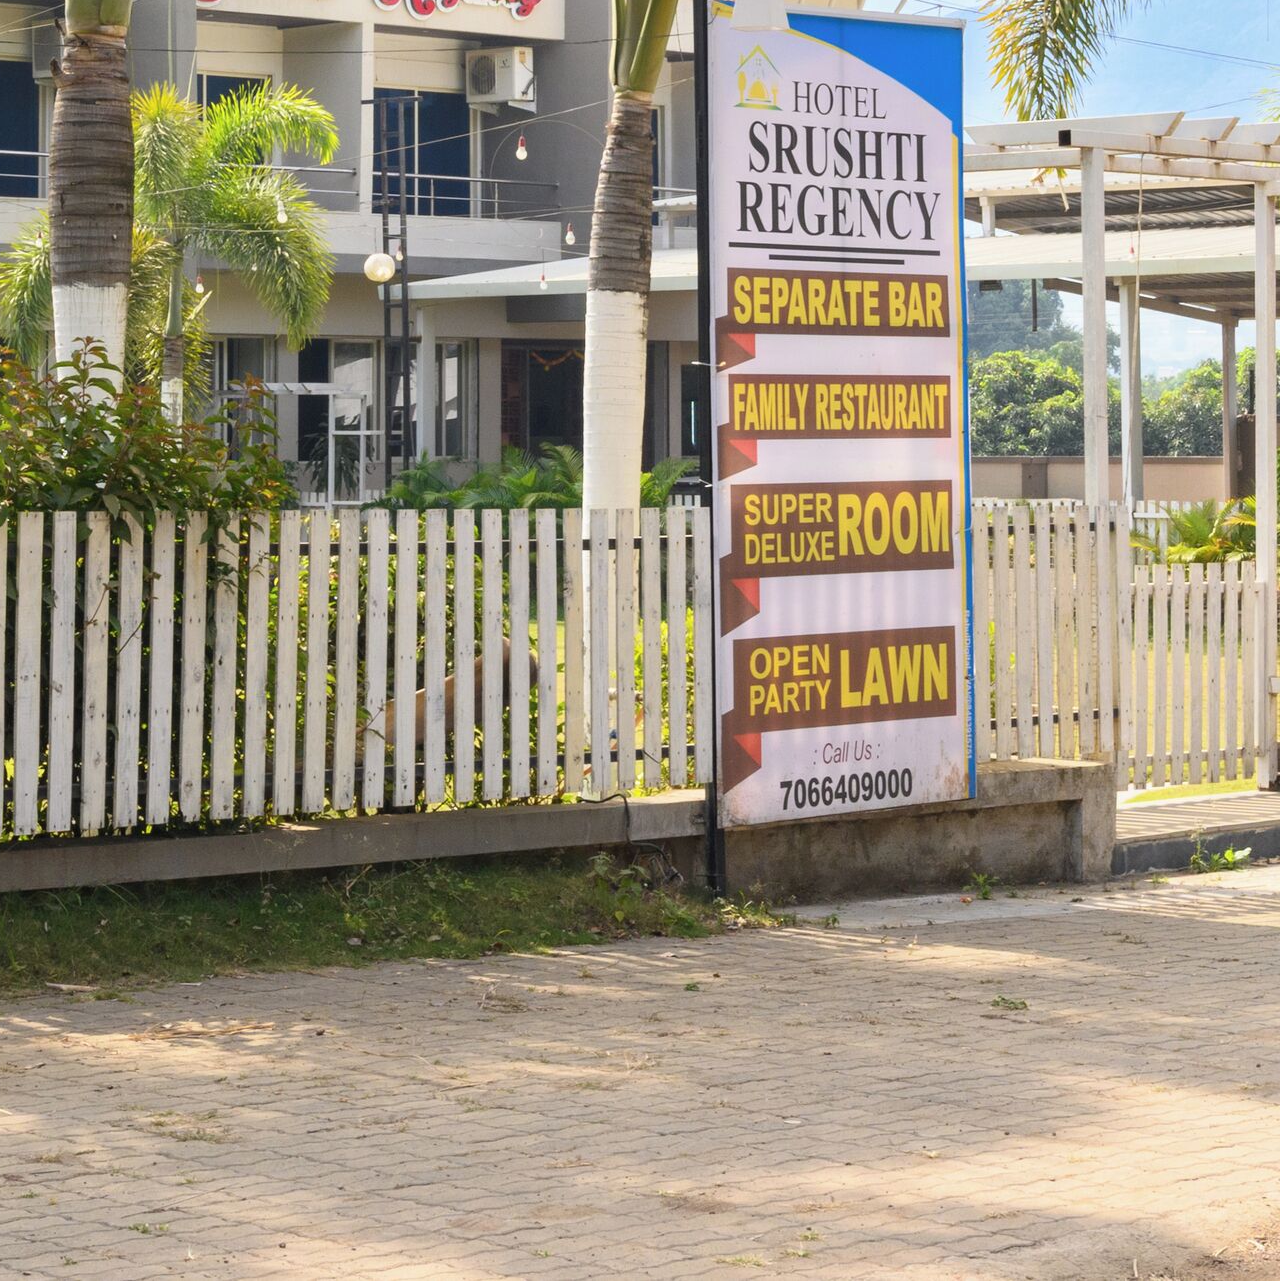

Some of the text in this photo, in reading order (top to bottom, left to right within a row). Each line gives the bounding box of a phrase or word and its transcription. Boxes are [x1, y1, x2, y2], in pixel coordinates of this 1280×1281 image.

[792, 80, 887, 119] HOTEL
[748, 120, 928, 183] SRUSHTI
[736, 181, 941, 241] REGENCY
[733, 275, 945, 329] SEPARATE BAR
[733, 382, 948, 431] FAMILY RESTAURANT
[744, 492, 834, 527] SUPER
[838, 490, 950, 556] ROOM
[745, 531, 835, 565] DELUXE
[749, 643, 831, 680] OPEN
[840, 643, 948, 709] LAWN
[749, 680, 830, 716] PARTY
[822, 742, 850, 765] Call
[853, 739, 872, 761] Us
[780, 768, 913, 811] 7066409000
